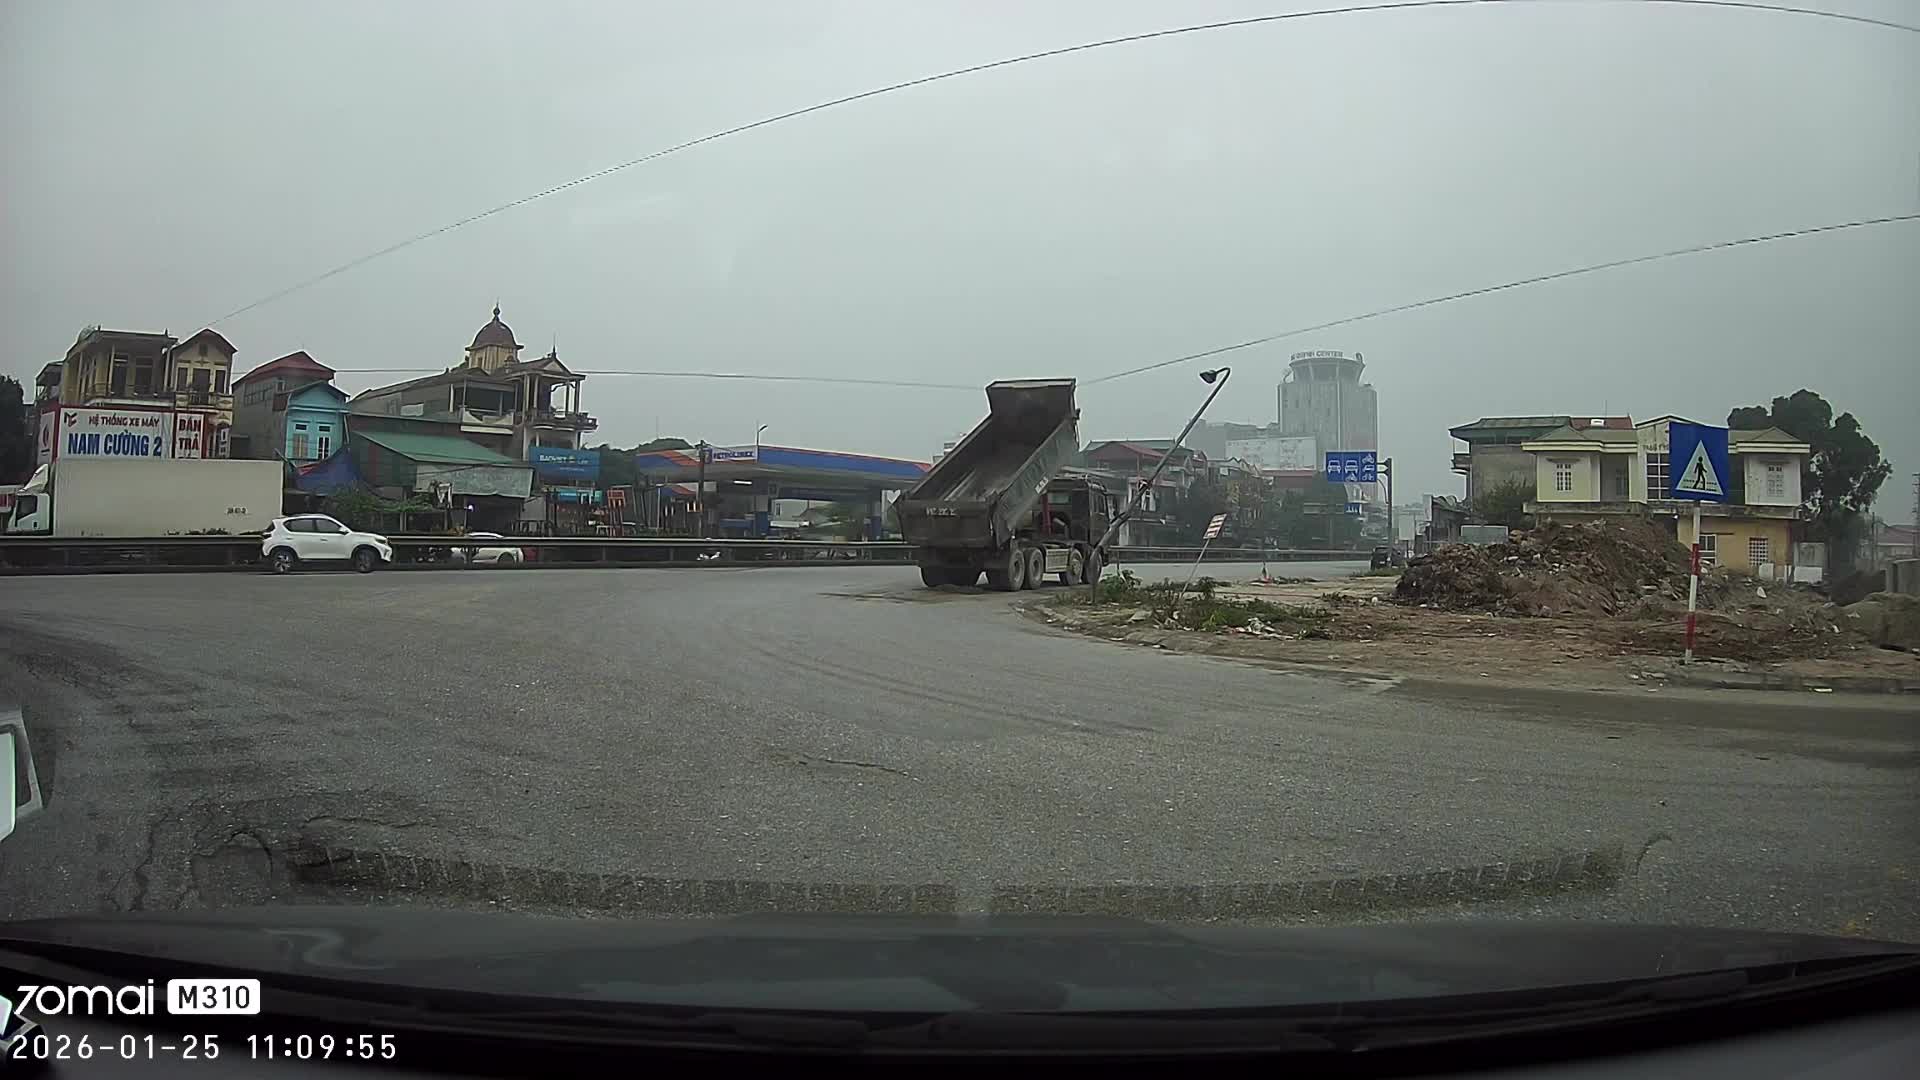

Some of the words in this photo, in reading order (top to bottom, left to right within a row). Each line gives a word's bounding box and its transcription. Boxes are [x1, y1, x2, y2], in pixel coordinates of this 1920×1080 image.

[100, 412, 128, 427] THỐNG
[129, 417, 140, 427] XE
[141, 416, 160, 428] MÁY
[68, 432, 101, 455] NAM
[103, 429, 149, 456] CƯỜNG
[152, 436, 162, 457] 2
